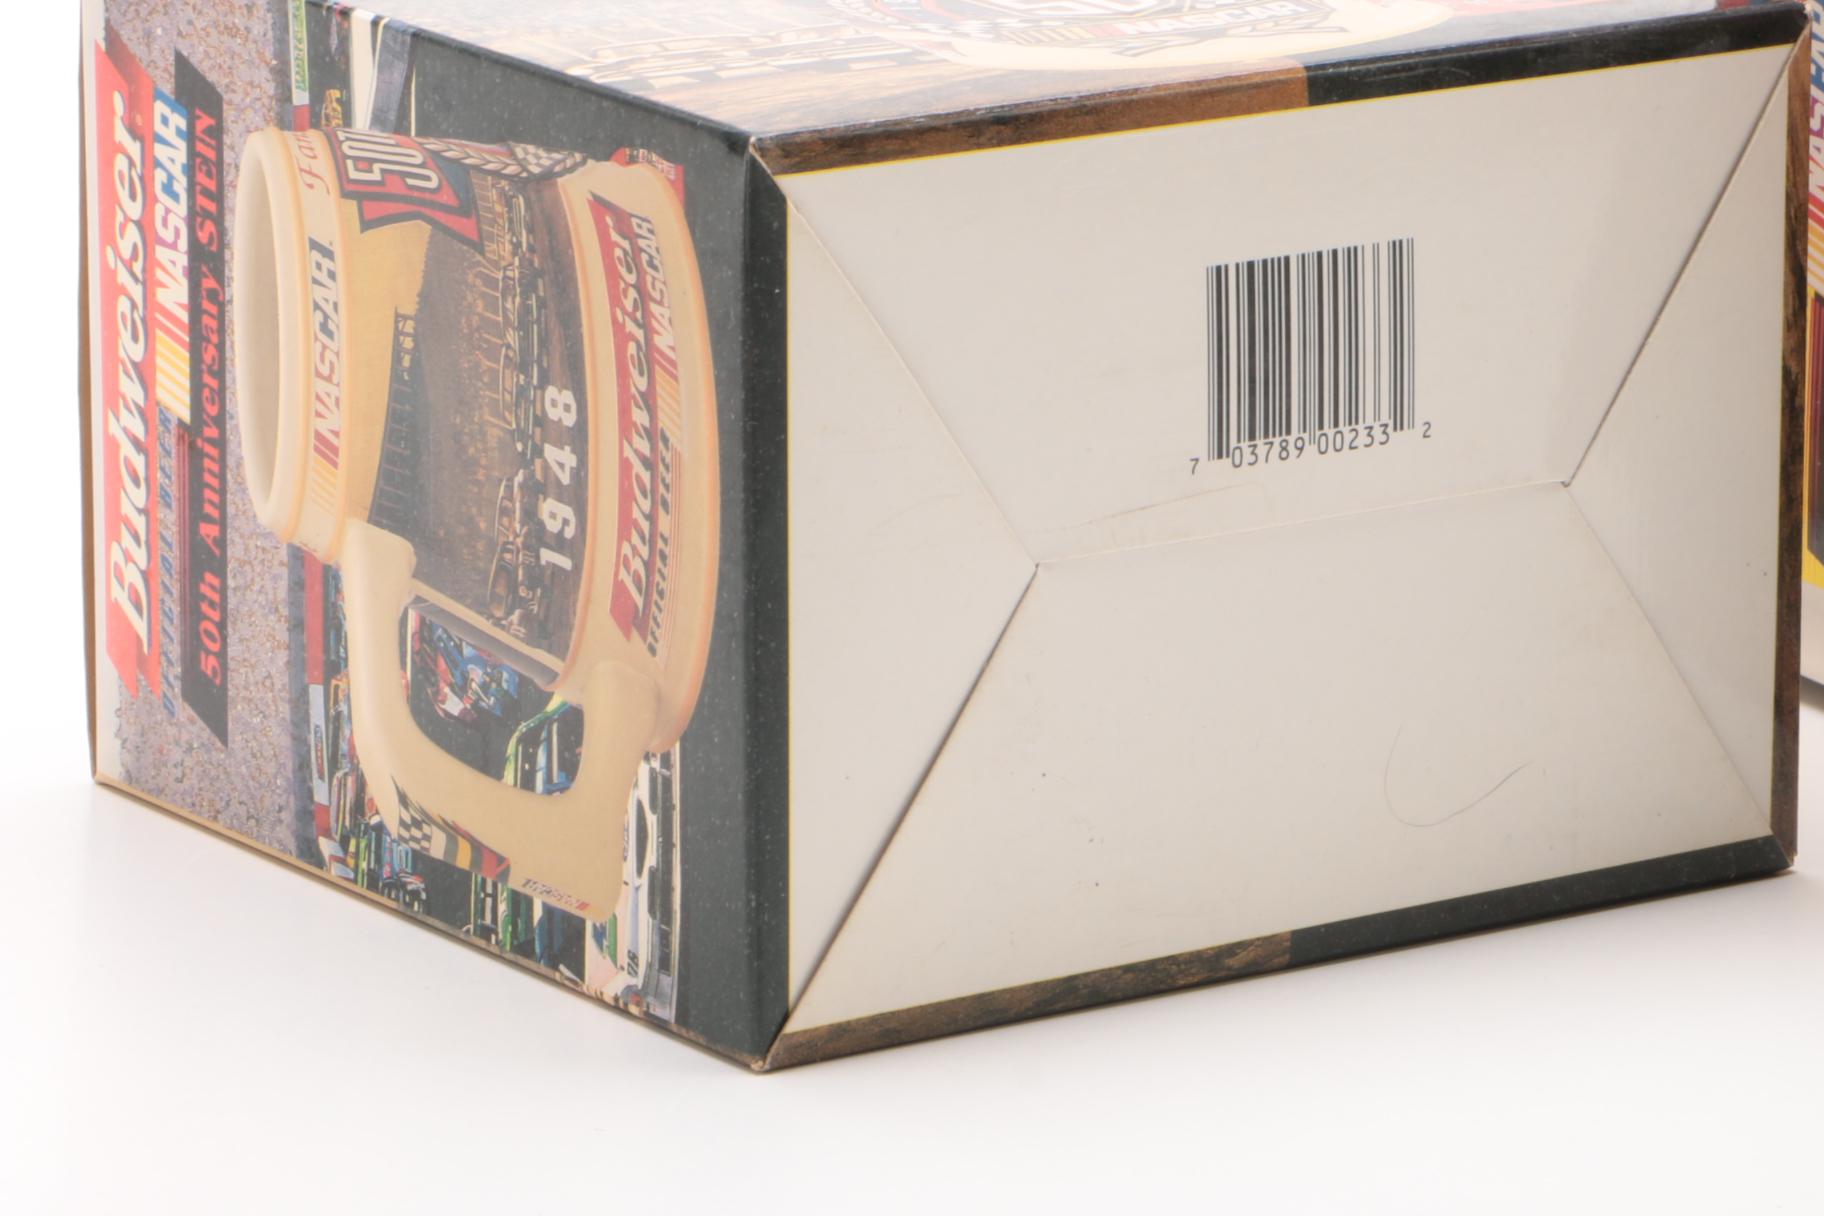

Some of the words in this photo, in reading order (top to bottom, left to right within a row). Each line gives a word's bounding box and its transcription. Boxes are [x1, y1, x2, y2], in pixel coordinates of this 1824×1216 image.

[153, 99, 189, 324] NASCAR
[195, 108, 219, 253] STEIN
[104, 89, 150, 656] Budweiser
[309, 241, 341, 448] NASCAR
[632, 216, 677, 363] NASCAR
[196, 265, 224, 557] Anniversary
[539, 385, 577, 572] 1948
[608, 215, 651, 618] Budweiser
[1188, 458, 1200, 475] 7
[1231, 436, 1306, 469] 03789
[1317, 423, 1391, 455] 00233
[1422, 421, 1432, 438] 2
[160, 532, 176, 719] OFFICIAL
[197, 573, 222, 686] 50th
